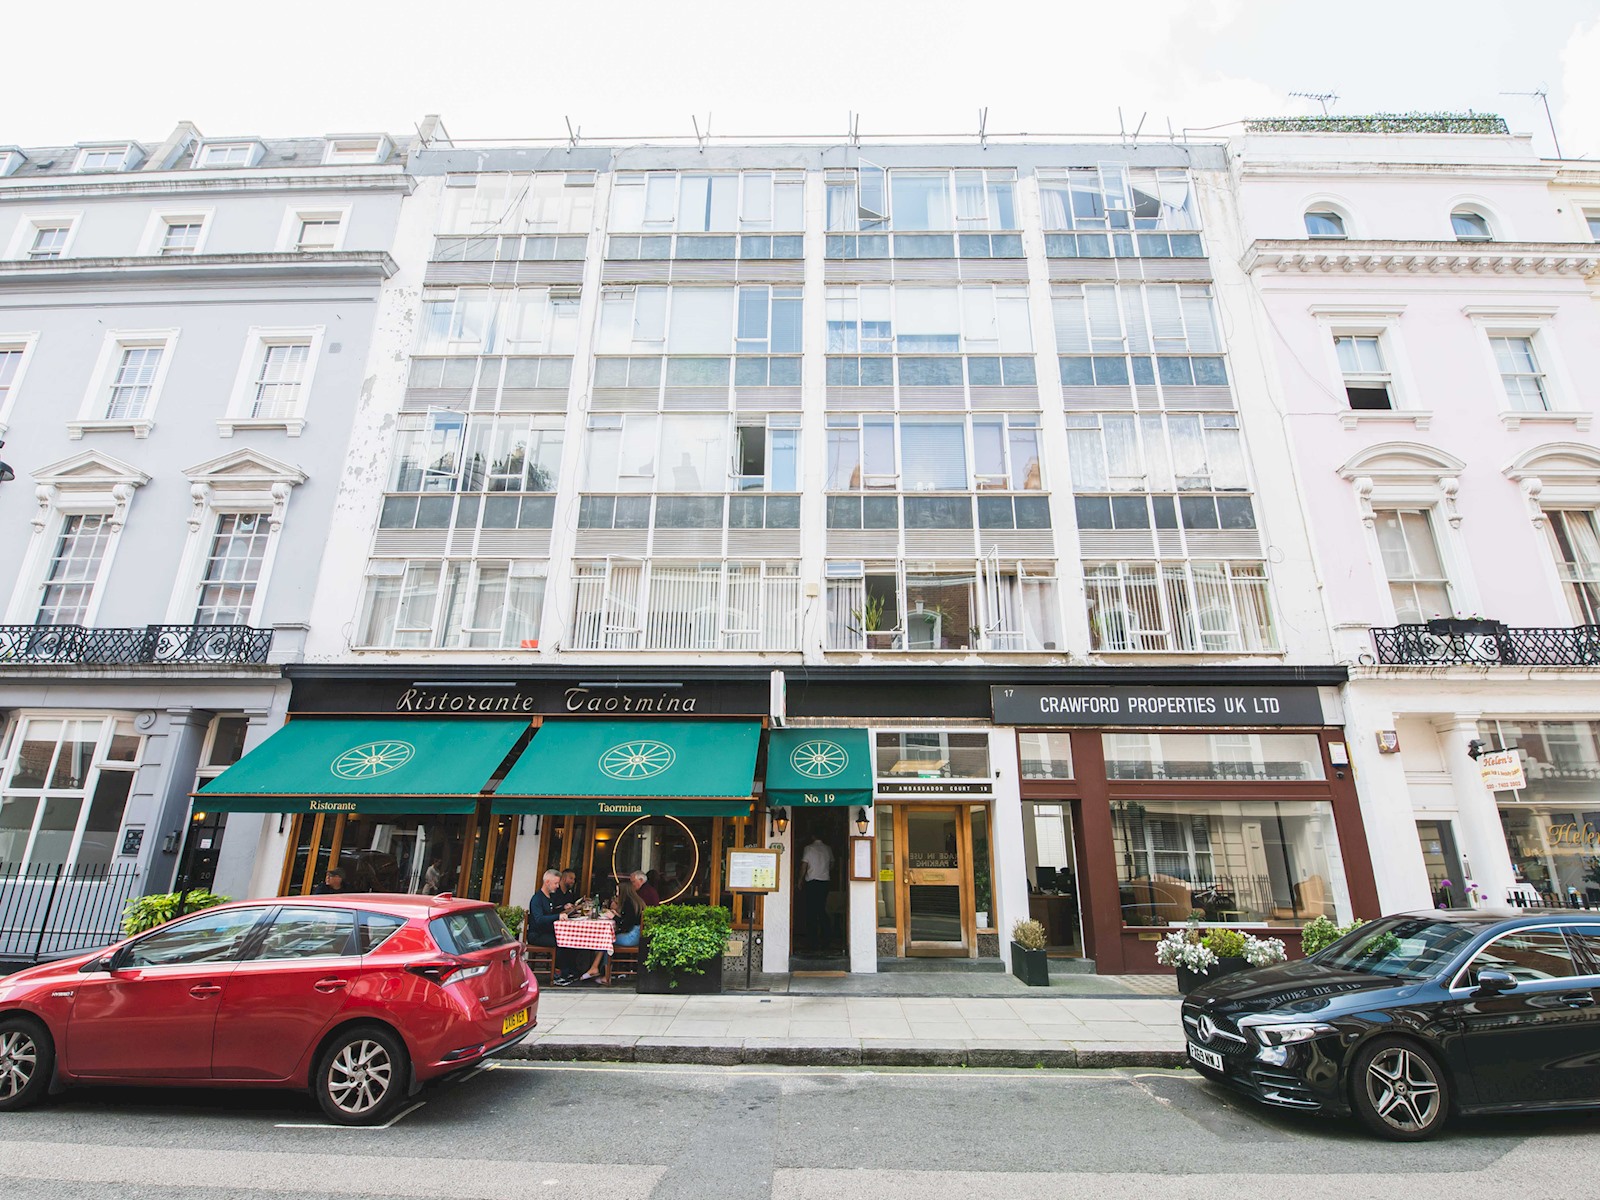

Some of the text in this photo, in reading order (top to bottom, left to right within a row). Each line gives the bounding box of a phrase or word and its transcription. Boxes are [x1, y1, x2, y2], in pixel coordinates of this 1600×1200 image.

[1004, 689, 1014, 697] 17
[396, 687, 696, 712] Ristorante Taormina
[1040, 697, 1280, 713] CRAWFORD PROPERTIES UK LTD
[1483, 755, 1513, 767] Helen's
[804, 793, 835, 803] No. 19
[309, 800, 357, 810] Ristorante
[598, 802, 642, 813] Taormina
[1547, 822, 1600, 846] Hele
